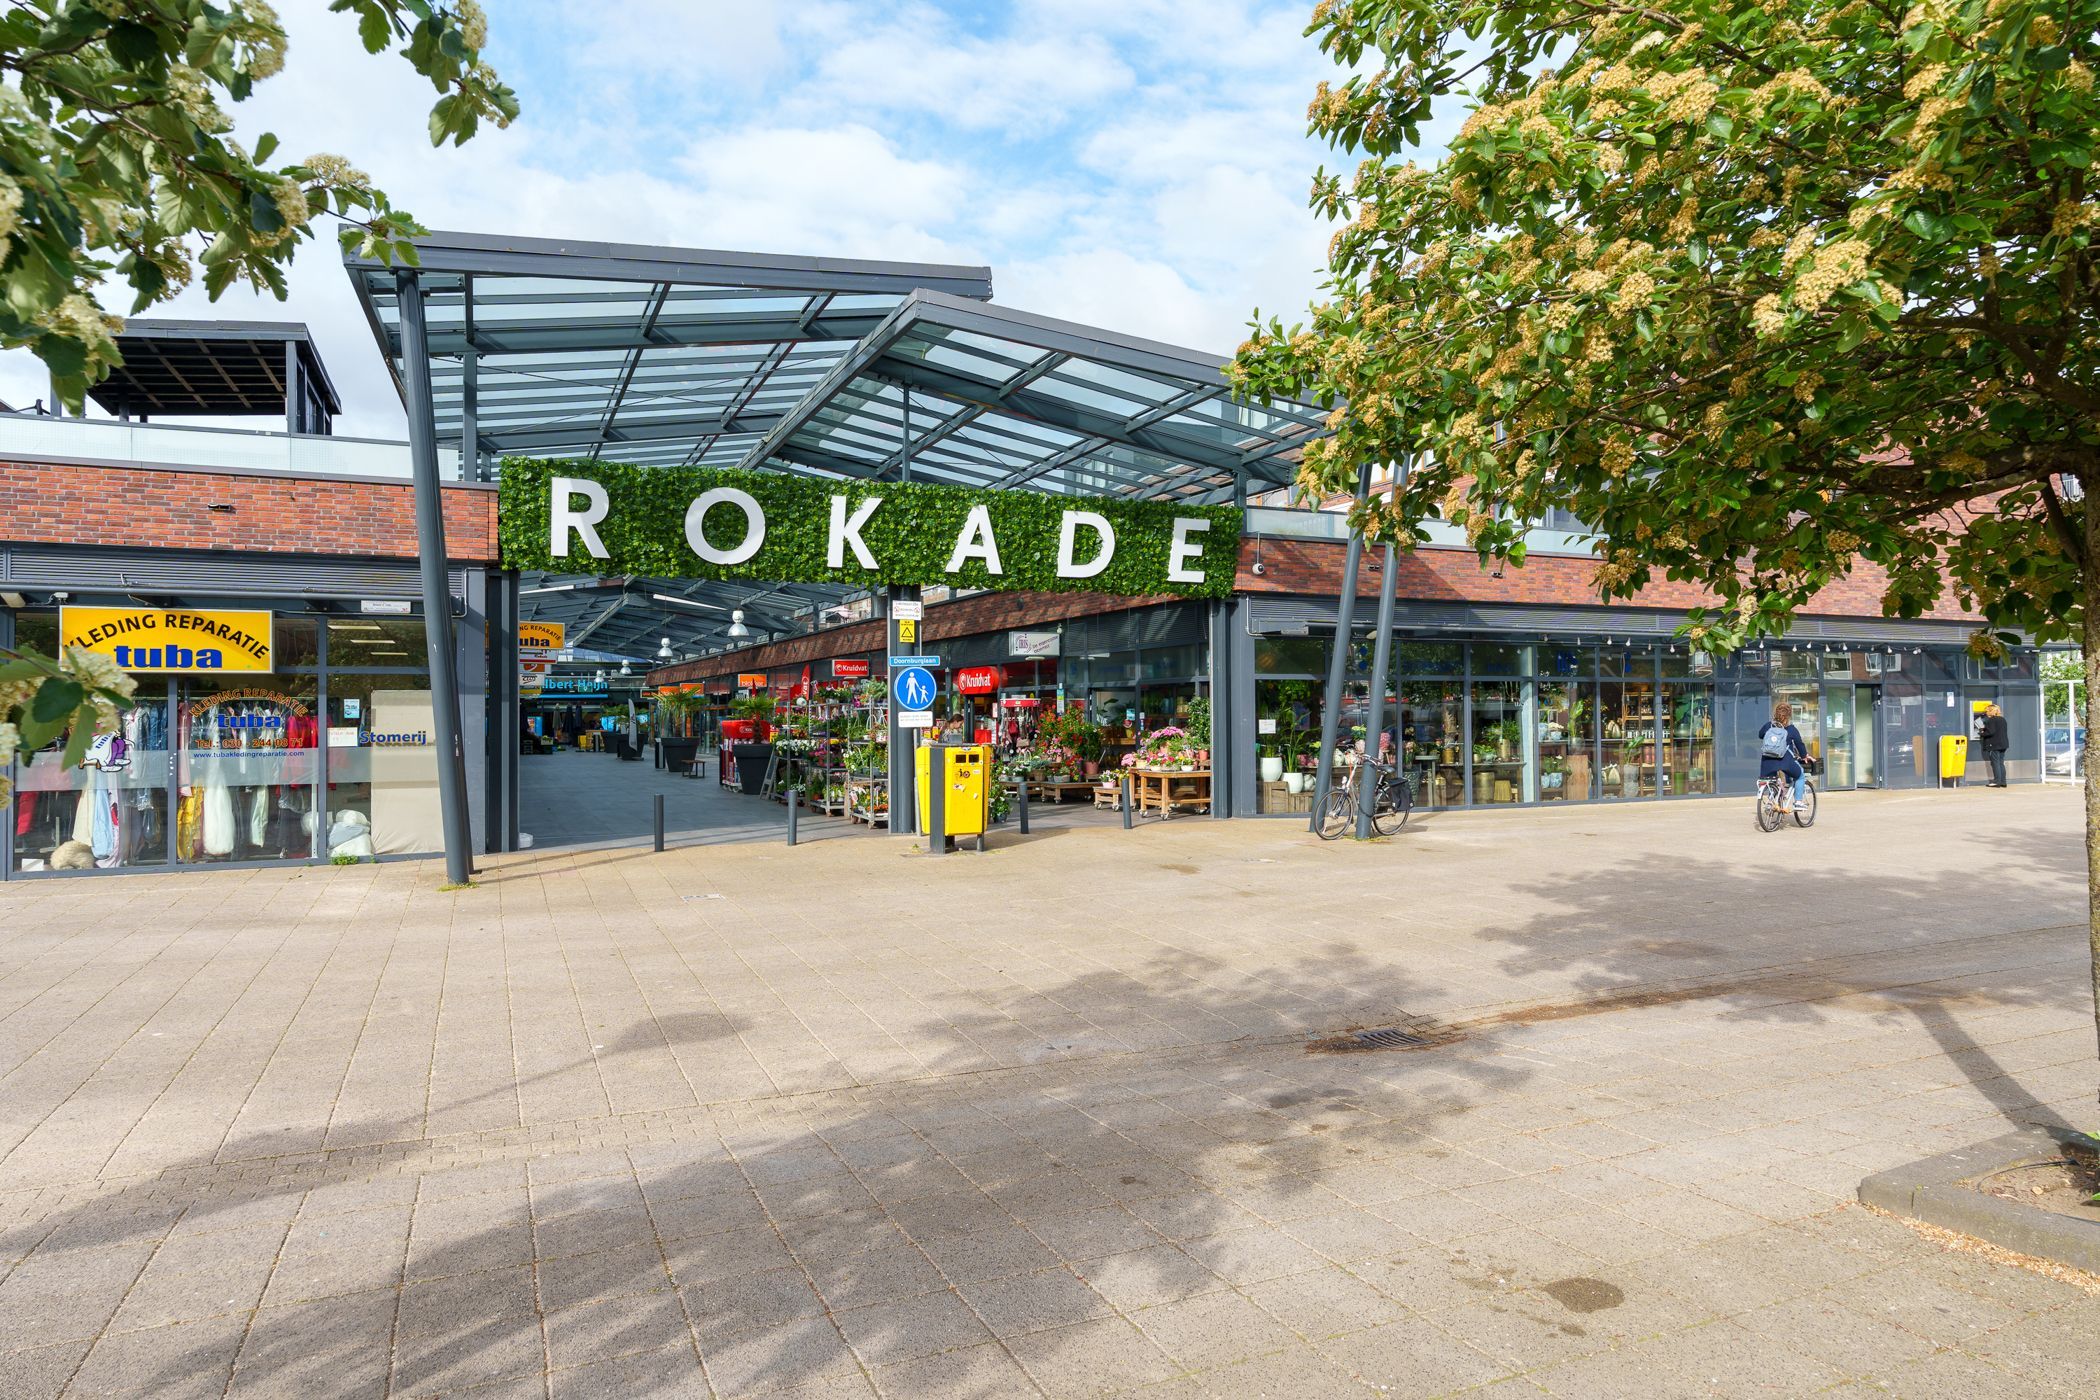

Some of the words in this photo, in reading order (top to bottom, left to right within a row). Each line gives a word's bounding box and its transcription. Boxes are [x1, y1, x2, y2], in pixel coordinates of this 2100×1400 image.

[550, 477, 1211, 582] ROKADE
[164, 614, 270, 660] REPARATIE
[531, 624, 562, 641] REPARATIE
[519, 637, 550, 646] uba
[113, 644, 223, 669] tuba
[842, 664, 868, 672] Kruidvat
[543, 679, 573, 689] lbert
[966, 673, 991, 688] Kruidvat
[188, 689, 241, 718] KLEDING
[243, 688, 309, 717] REPARATIE
[215, 713, 281, 728] tuba
[252, 738, 272, 748] 244
[290, 738, 304, 747] 71
[360, 730, 427, 746] Stomerij
[193, 750, 306, 759] www.tubakledingreparatie.com
